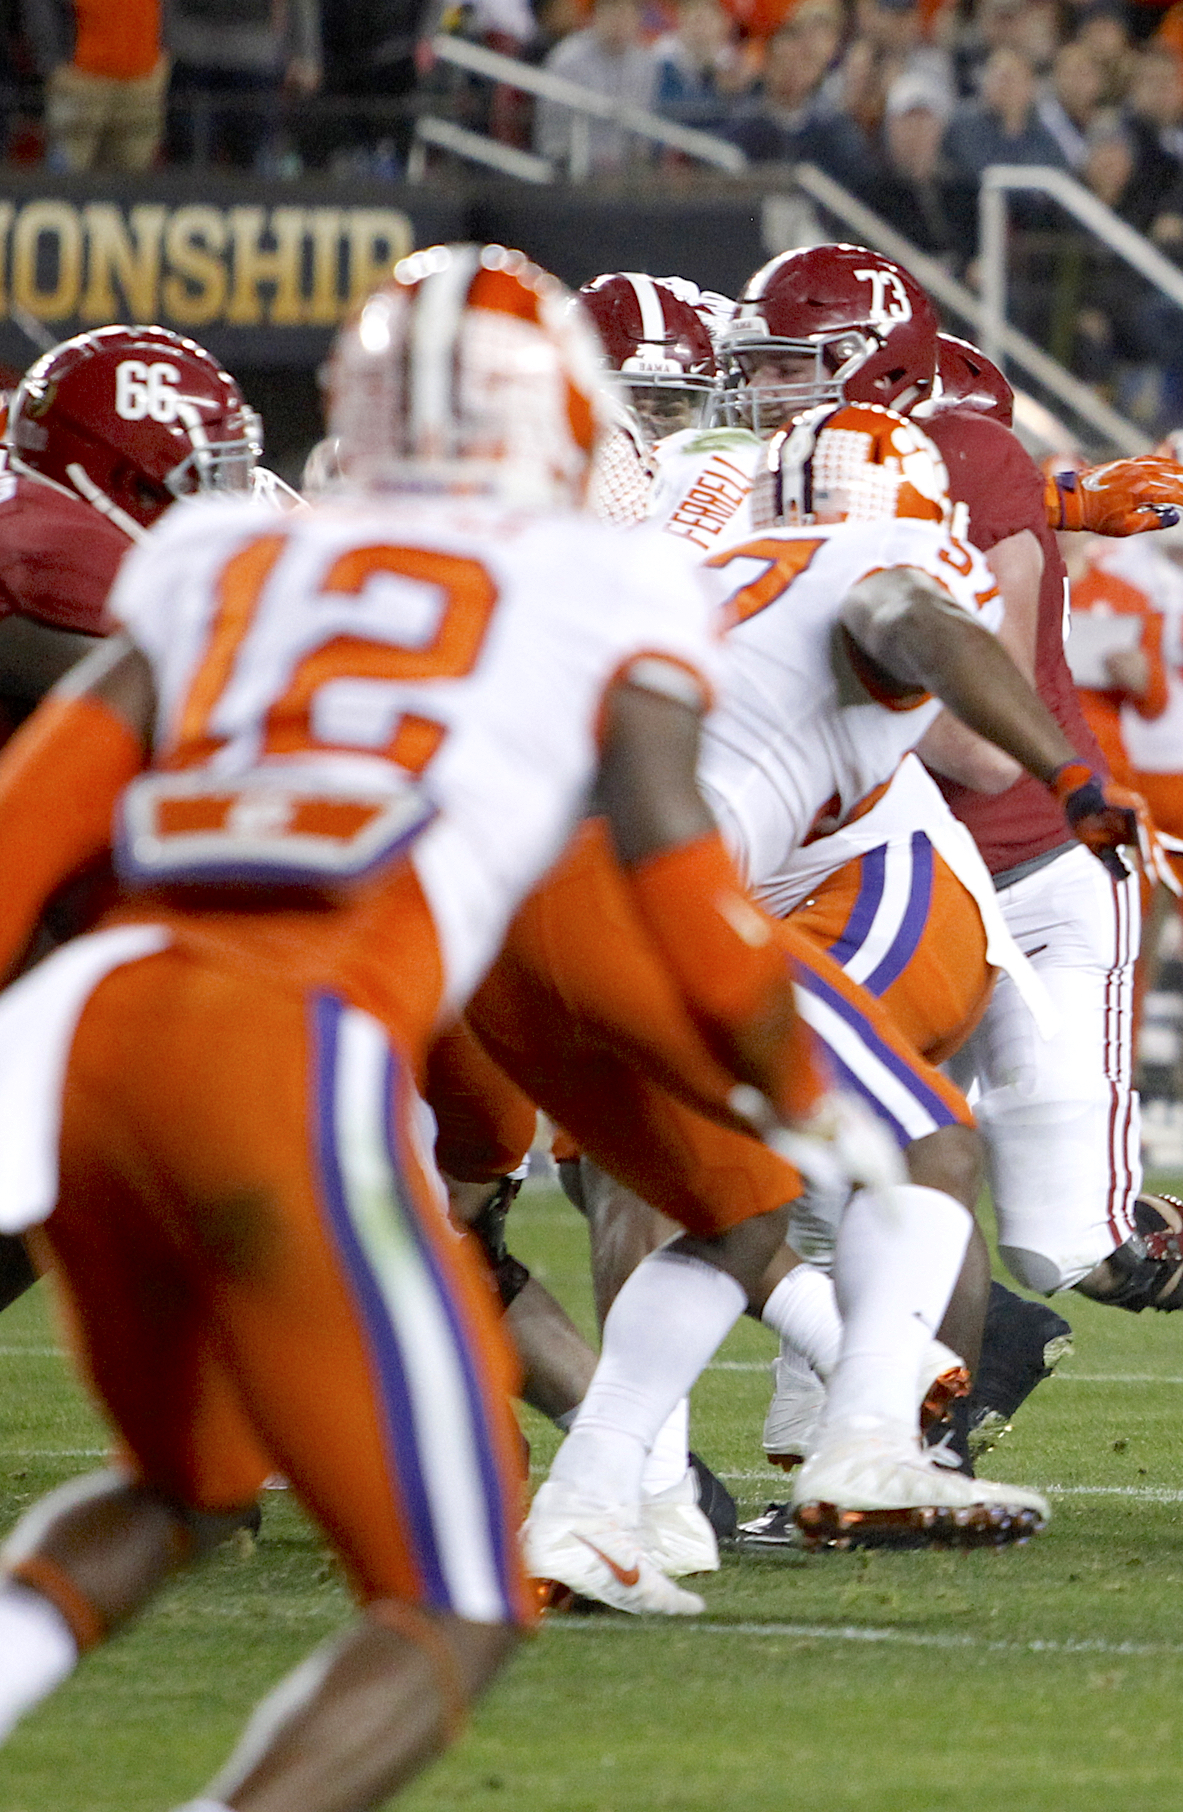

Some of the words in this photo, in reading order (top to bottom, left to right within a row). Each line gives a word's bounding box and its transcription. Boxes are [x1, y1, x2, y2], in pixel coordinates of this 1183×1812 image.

[853, 269, 912, 322] 73
[116, 360, 181, 423] 66
[638, 362, 670, 373] BAMA
[662, 455, 756, 550] FERRELL
[155, 532, 500, 784] 12
